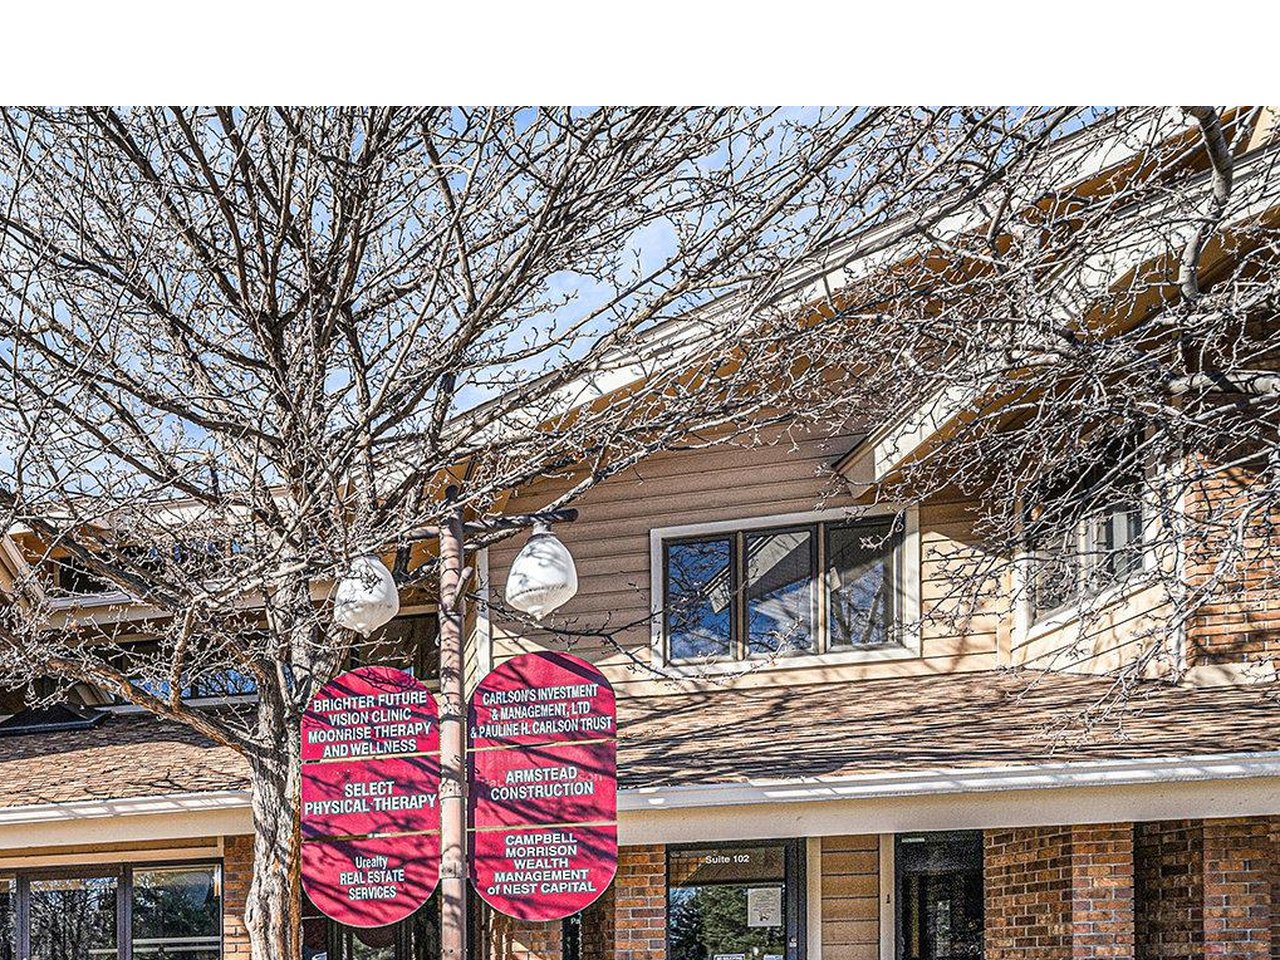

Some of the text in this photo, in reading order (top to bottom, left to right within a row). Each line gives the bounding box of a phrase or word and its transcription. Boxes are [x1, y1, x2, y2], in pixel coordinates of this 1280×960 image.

[313, 691, 427, 712] BRIGHTER FUTURE
[482, 684, 599, 706] CARLSON'S INVESTMENT
[329, 708, 412, 727] VISION CLINIC
[491, 701, 591, 721] & MANAGEMENT, LTD
[308, 722, 432, 744] MOONRISE THERAPY
[470, 727, 478, 738] &
[479, 723, 518, 738] PAULINE
[533, 718, 579, 734] CARLSON
[580, 716, 613, 730] TRUST
[323, 739, 417, 757] AND WELLNESS
[505, 766, 578, 784] ARMSTEAD
[345, 781, 395, 797] SELECT
[491, 781, 595, 801] CONSTRUCTION
[304, 794, 437, 815] PHYSICAL THERAPY
[505, 833, 578, 846] CAMPBELL
[505, 845, 578, 858] MORRISON
[705, 854, 750, 865] Suite 102
[355, 856, 388, 870] Urealty
[514, 858, 569, 870] WEALTH
[340, 869, 405, 885] REAL ESTATE
[494, 869, 590, 883] MANAGEMENT
[349, 885, 397, 900] SERVICES
[487, 881, 597, 895] of NEST CAPITAL
